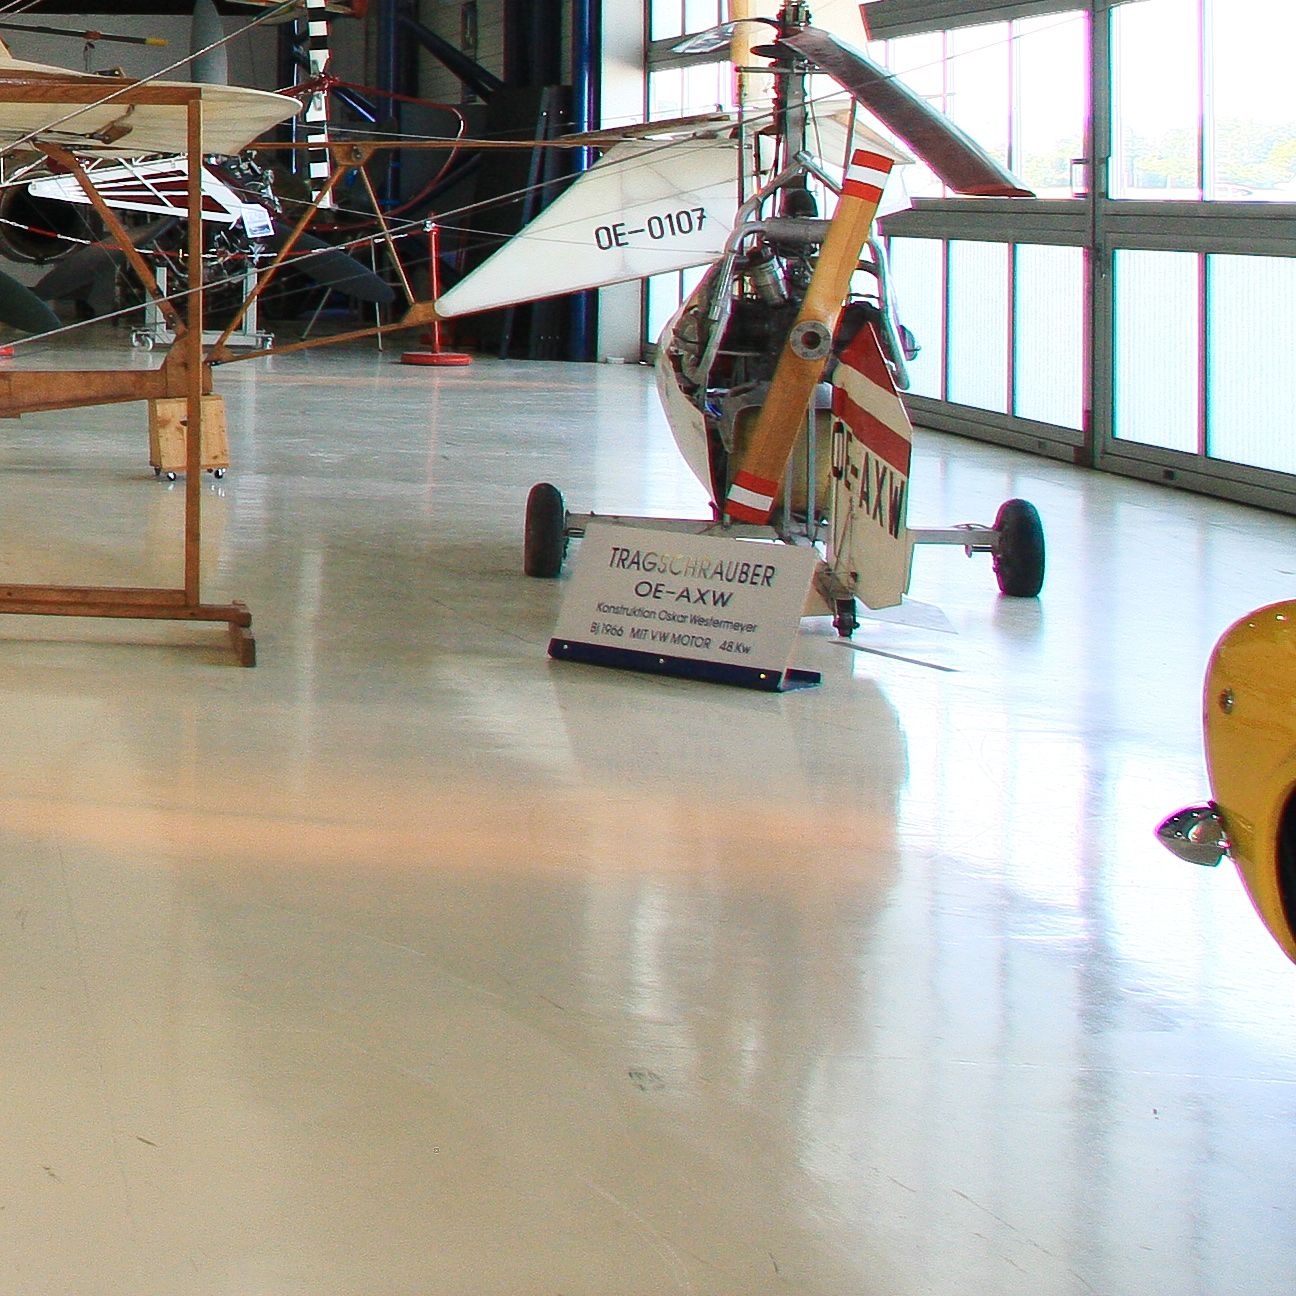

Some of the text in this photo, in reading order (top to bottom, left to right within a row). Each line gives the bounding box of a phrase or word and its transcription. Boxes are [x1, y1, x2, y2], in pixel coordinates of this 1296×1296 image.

[594, 207, 707, 250] OE-0107
[831, 421, 906, 540] OE-AXW
[608, 546, 776, 587] TRAGSCHRAUBER
[634, 580, 734, 608] OE-AXW
[595, 601, 758, 634] Konstruktion Oskar Westermeyer
[629, 627, 648, 640] MIT
[650, 629, 670, 642] VW
[670, 632, 712, 650] MOTOR
